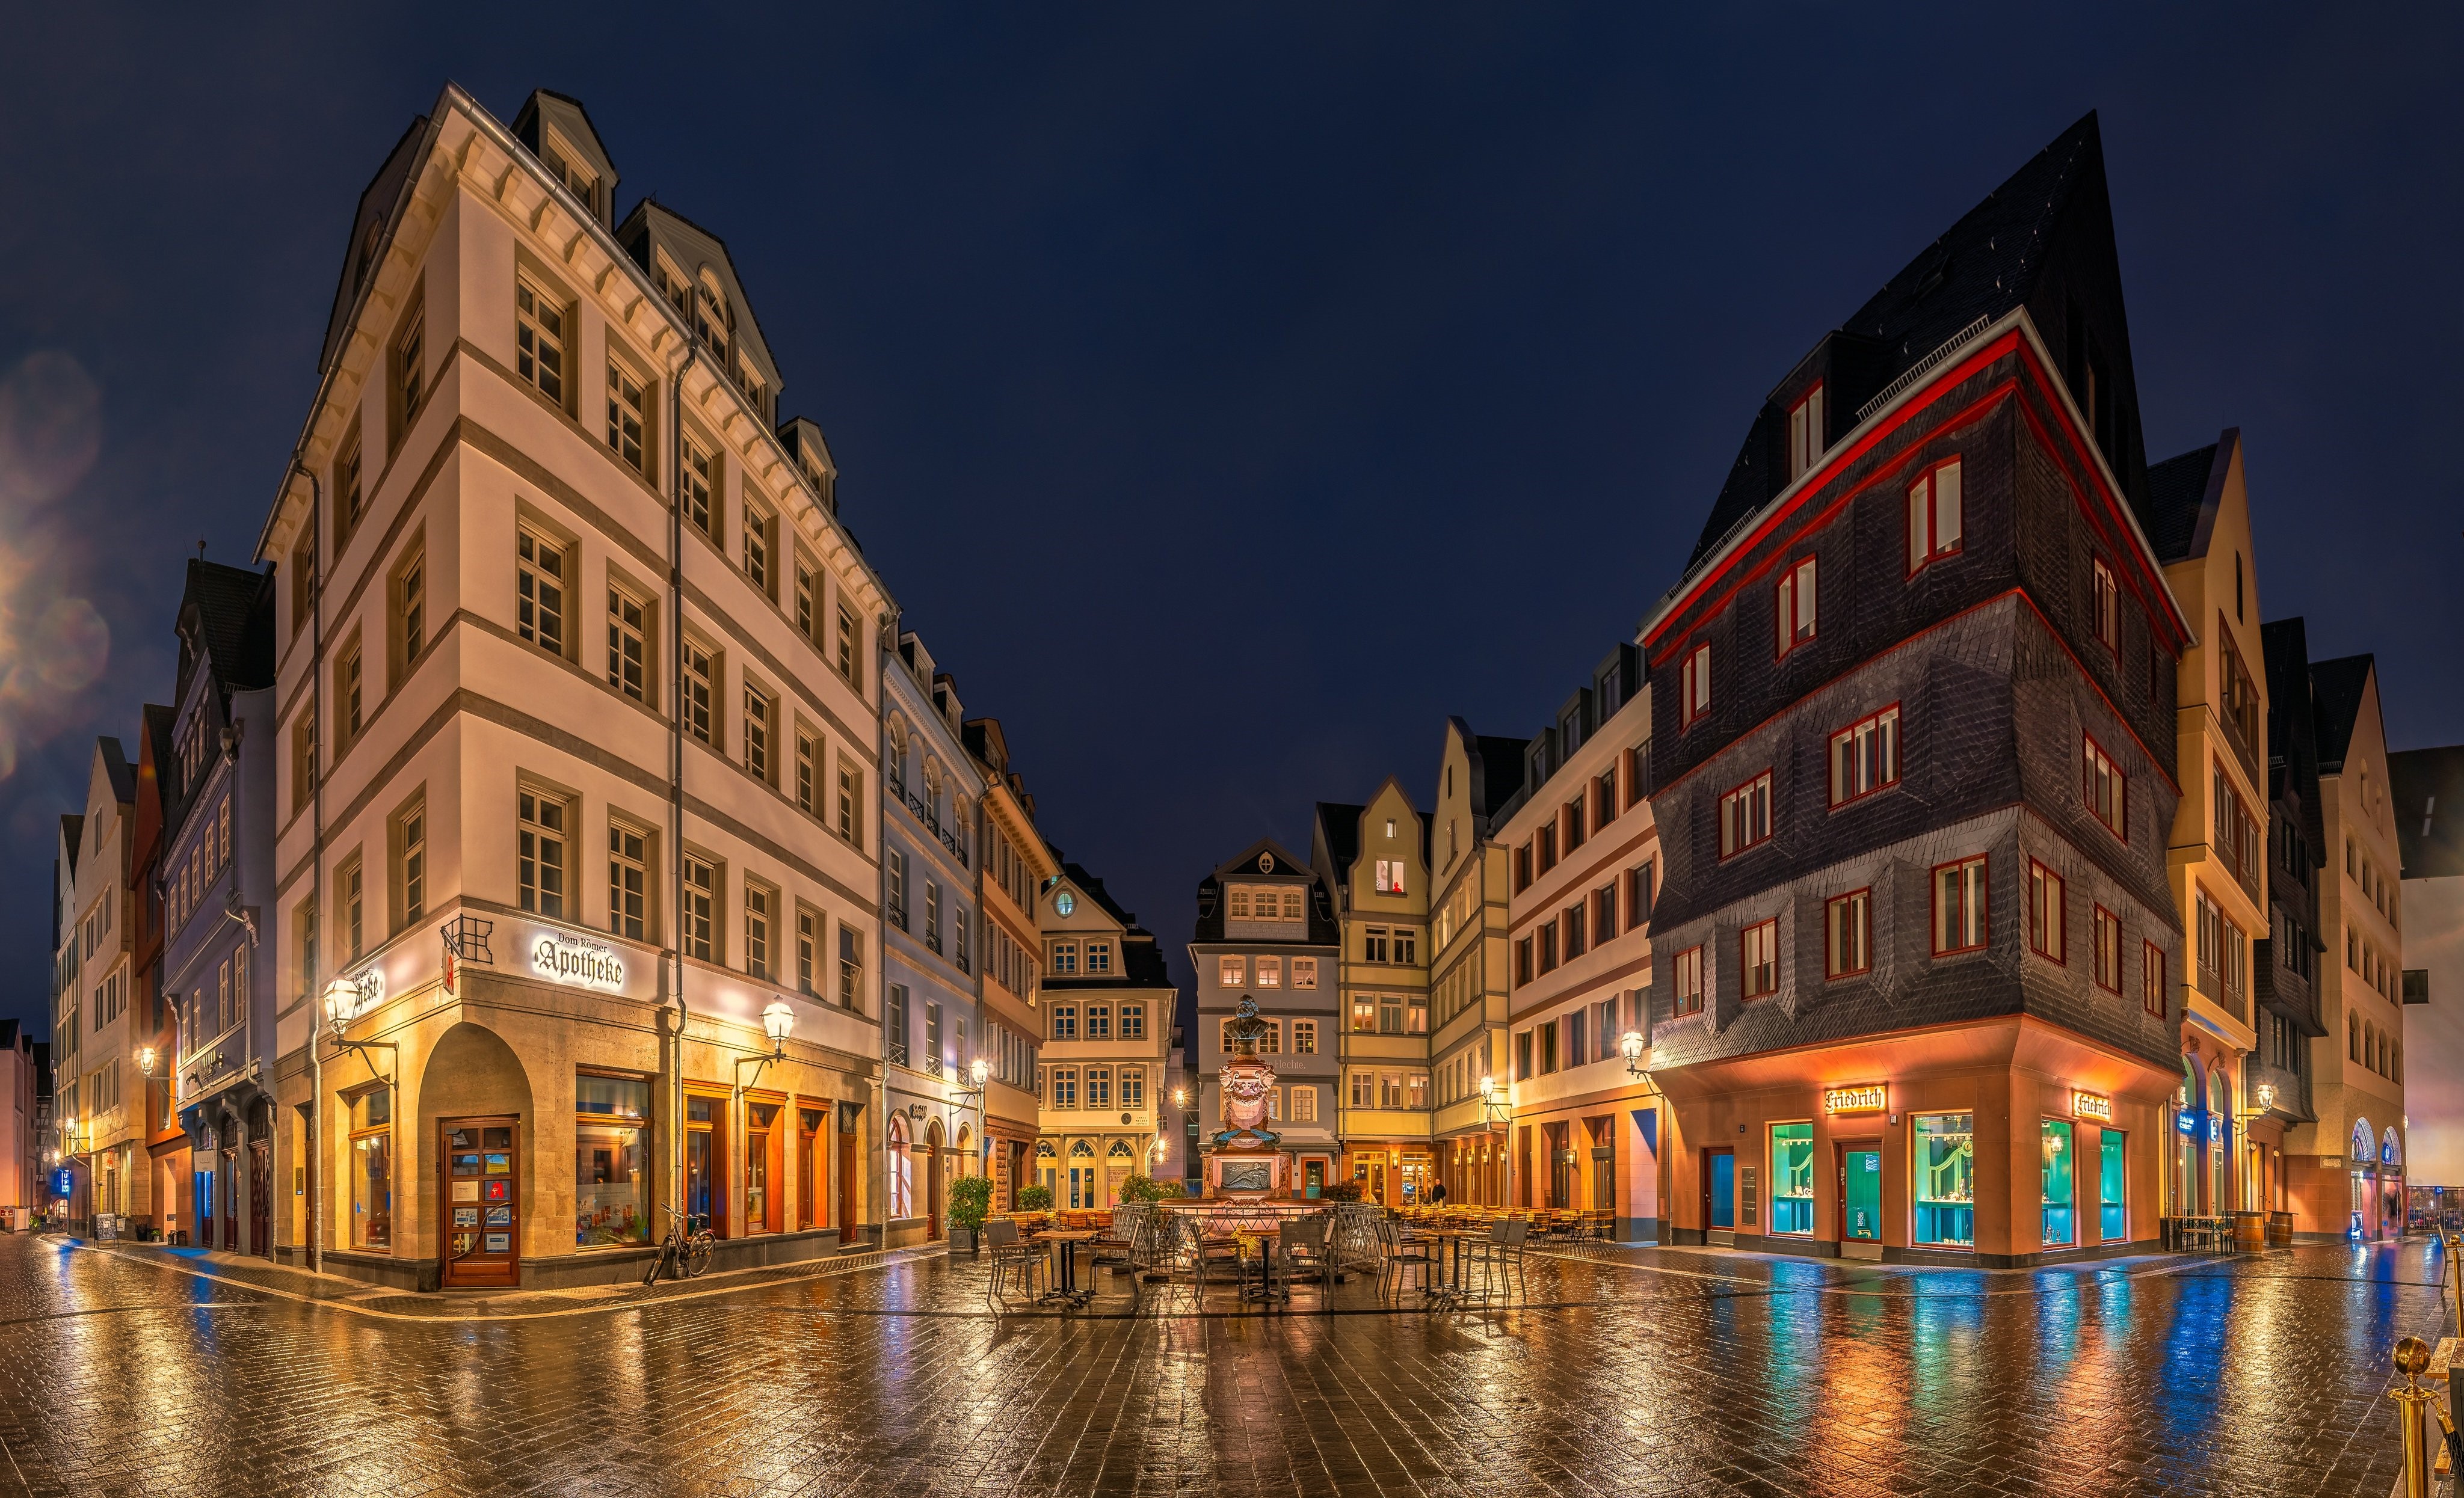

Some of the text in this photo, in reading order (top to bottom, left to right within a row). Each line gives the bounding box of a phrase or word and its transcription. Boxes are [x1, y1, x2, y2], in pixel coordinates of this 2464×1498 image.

[558, 933, 608, 953] Dom Römer
[539, 941, 622, 986] Apotheke
[1825, 1088, 1882, 1112] Friedrich
[2077, 1094, 2111, 1120] Friedrich
